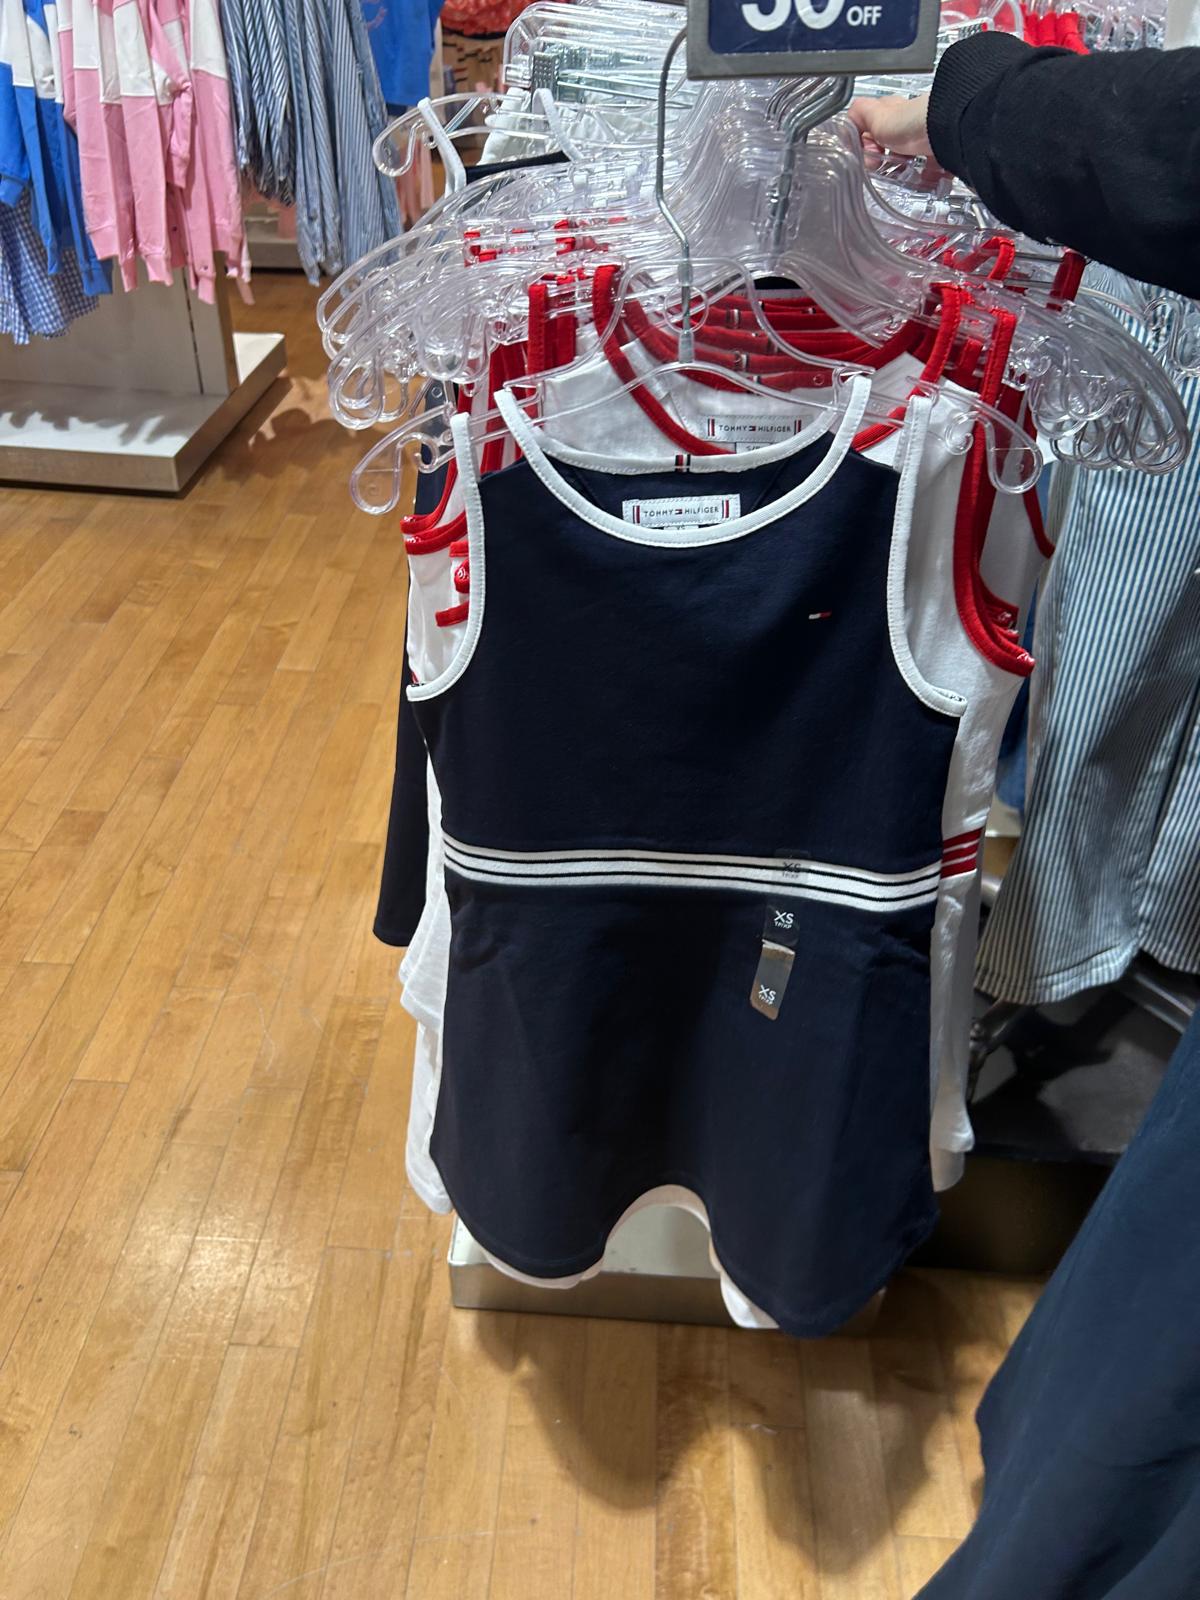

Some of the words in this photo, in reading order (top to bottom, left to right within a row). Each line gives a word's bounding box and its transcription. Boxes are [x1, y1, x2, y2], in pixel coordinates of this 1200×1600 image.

[847, 6, 882, 26] OFF
[718, 424, 747, 432] TOMMY
[758, 425, 792, 433] HILFIGER
[644, 510, 673, 518] TOMMY
[684, 506, 719, 514] HILFIGER
[774, 910, 794, 925] XS
[758, 984, 776, 1001] XS
